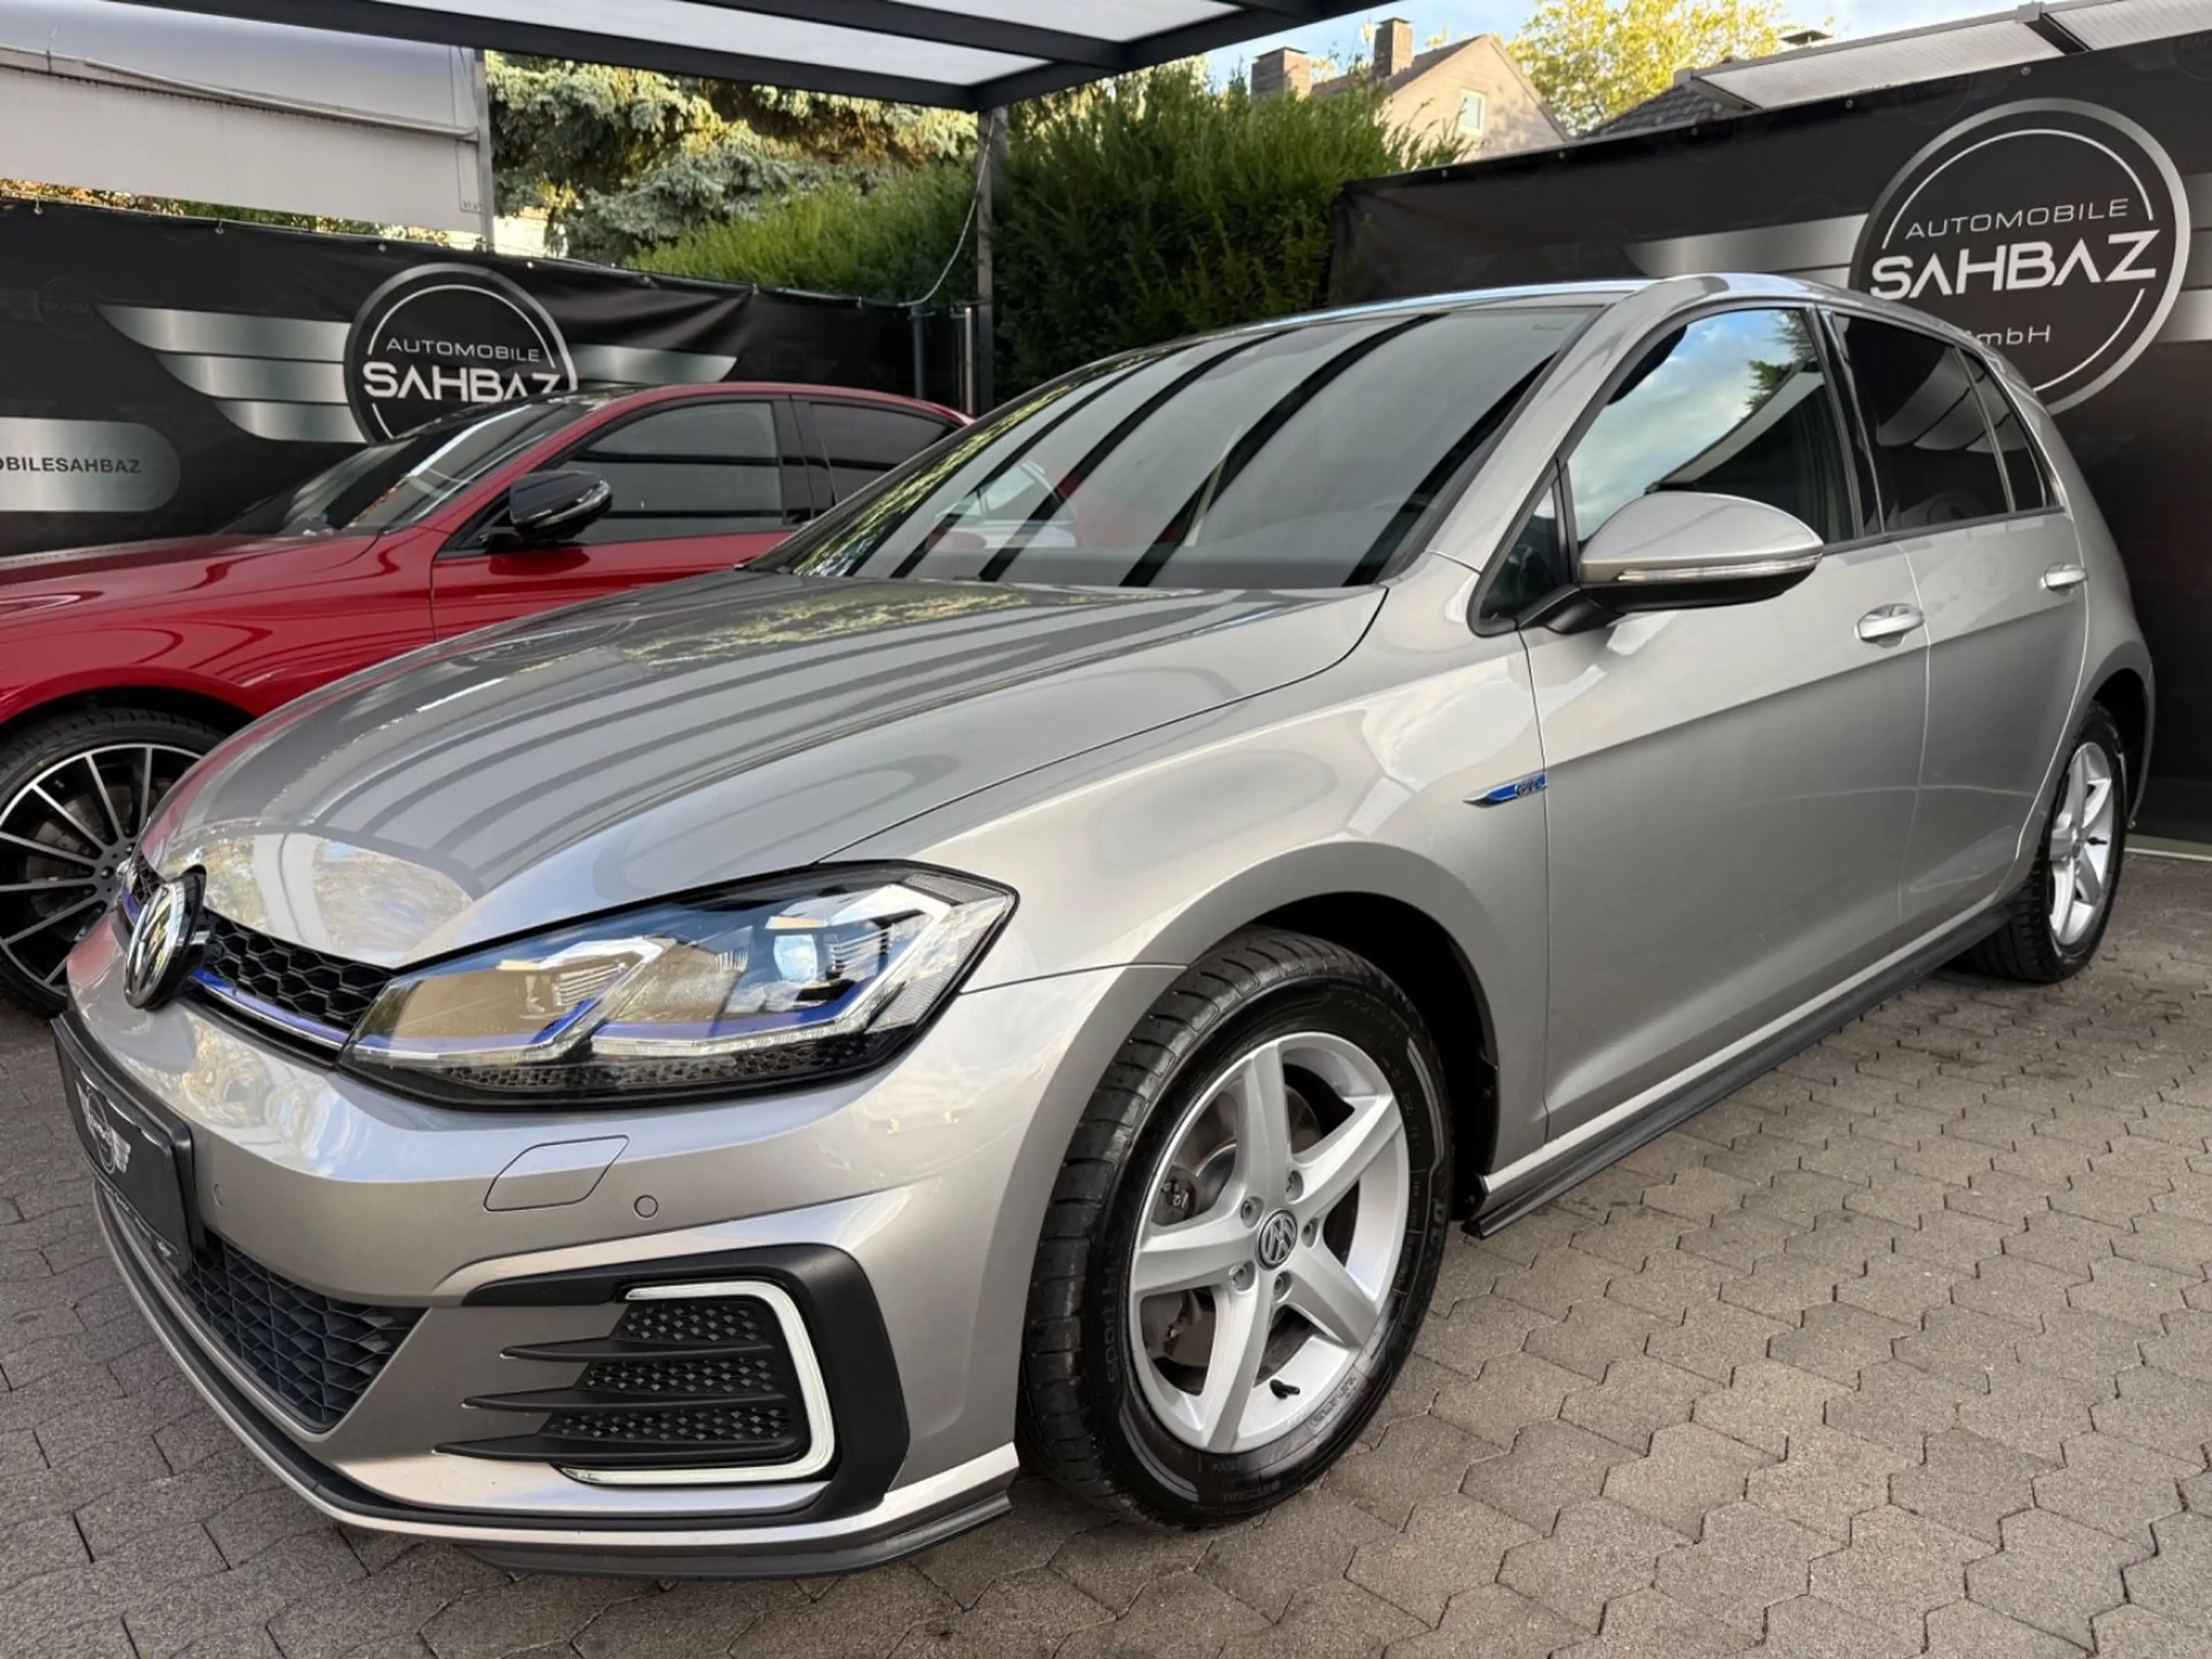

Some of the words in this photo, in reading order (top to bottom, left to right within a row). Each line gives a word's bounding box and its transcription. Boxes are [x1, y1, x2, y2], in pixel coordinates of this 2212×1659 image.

[1905, 198, 2129, 240] AUTOMOBILE
[1870, 229, 2160, 300] SAHBAZ
[386, 338, 540, 362] AUTOMOBILE
[1965, 324, 2051, 346] mbH
